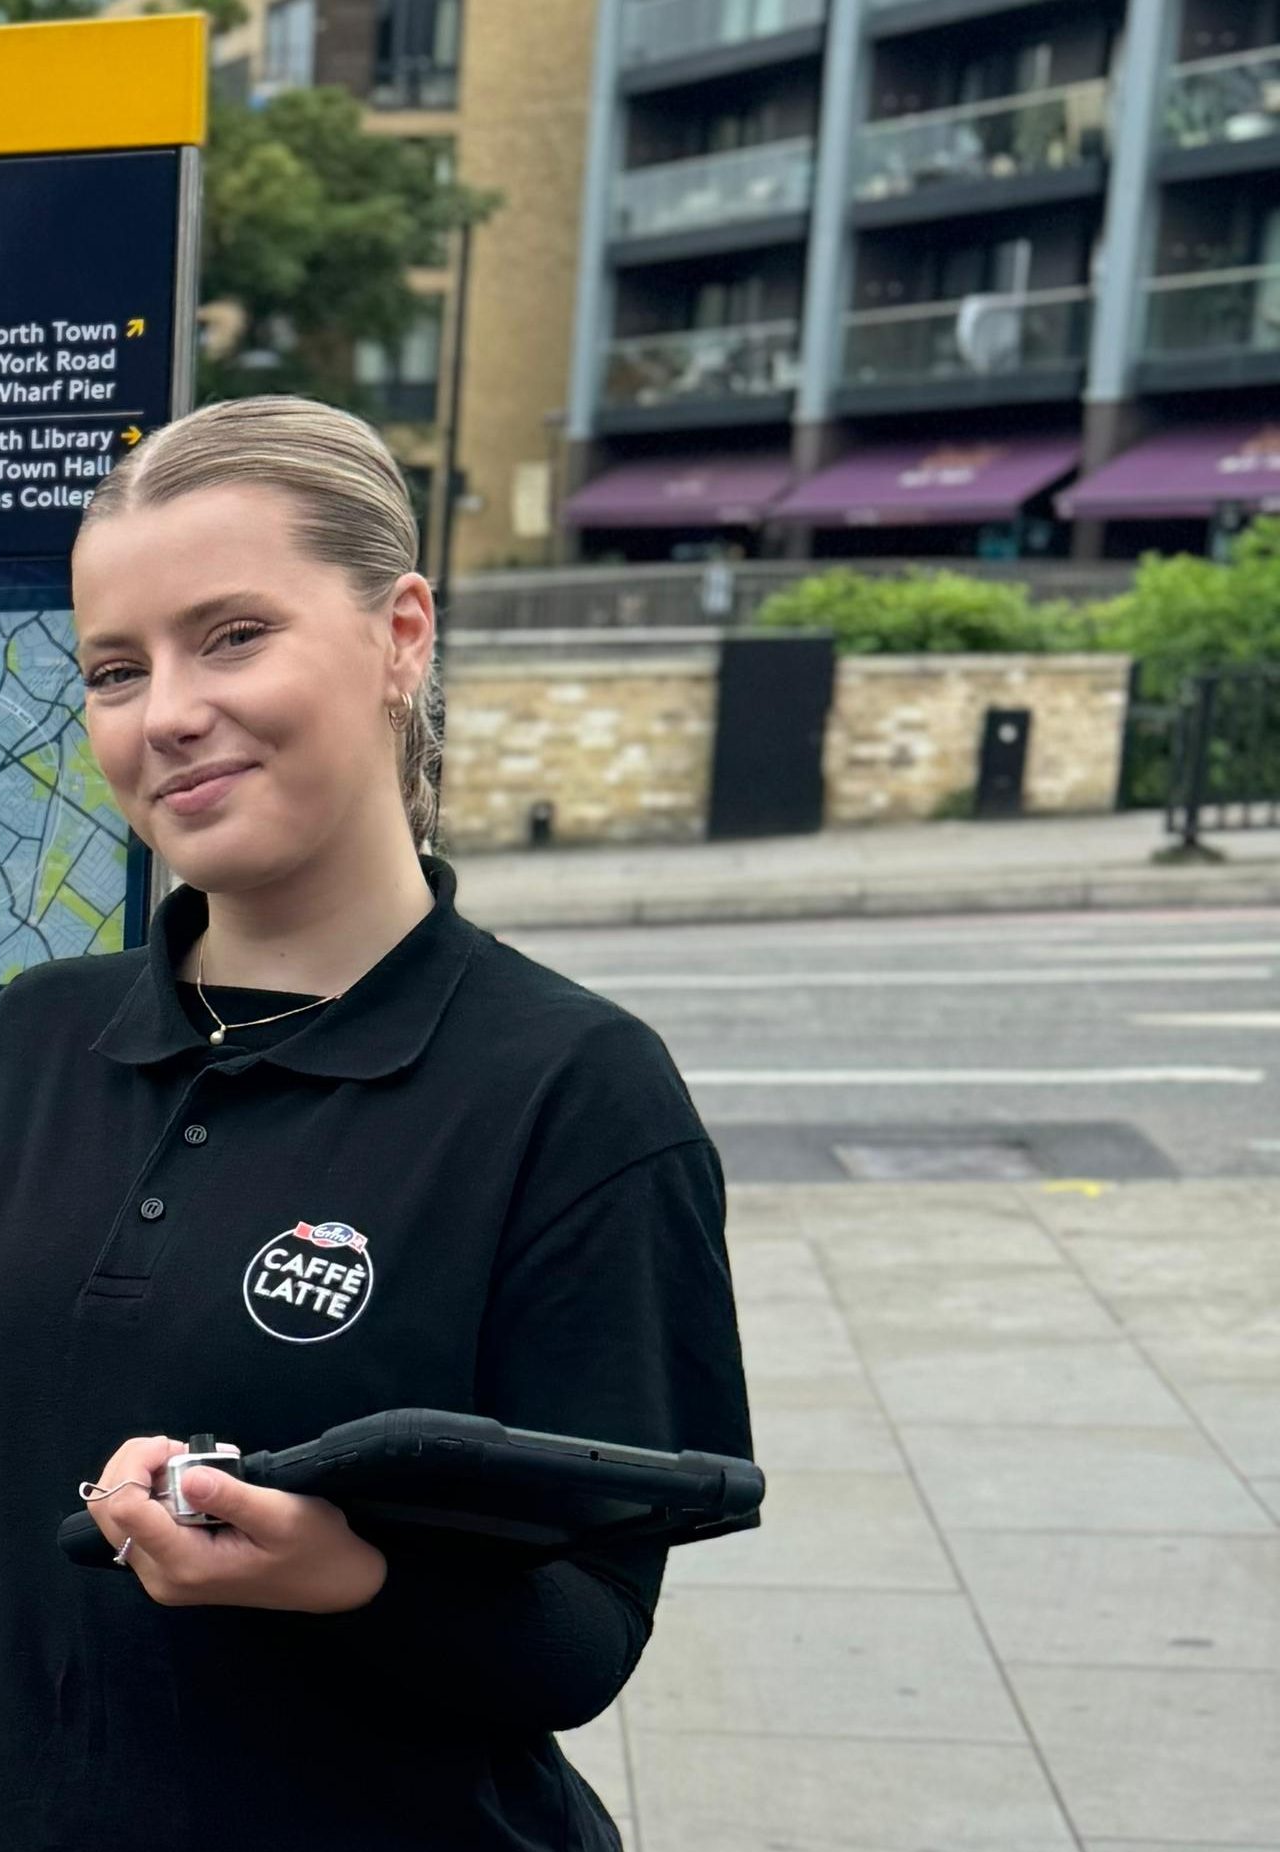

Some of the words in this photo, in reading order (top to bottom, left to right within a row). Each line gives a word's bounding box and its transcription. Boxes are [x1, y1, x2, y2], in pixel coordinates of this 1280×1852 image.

[52, 321, 116, 343] Town
[56, 348, 116, 372] Road
[69, 379, 116, 400] Pier
[30, 428, 113, 451] Library
[64, 455, 112, 477] Hall
[20, 486, 95, 508] Colleg
[264, 1248, 367, 1295] CAFFÈ
[253, 1270, 351, 1319] LATTE
